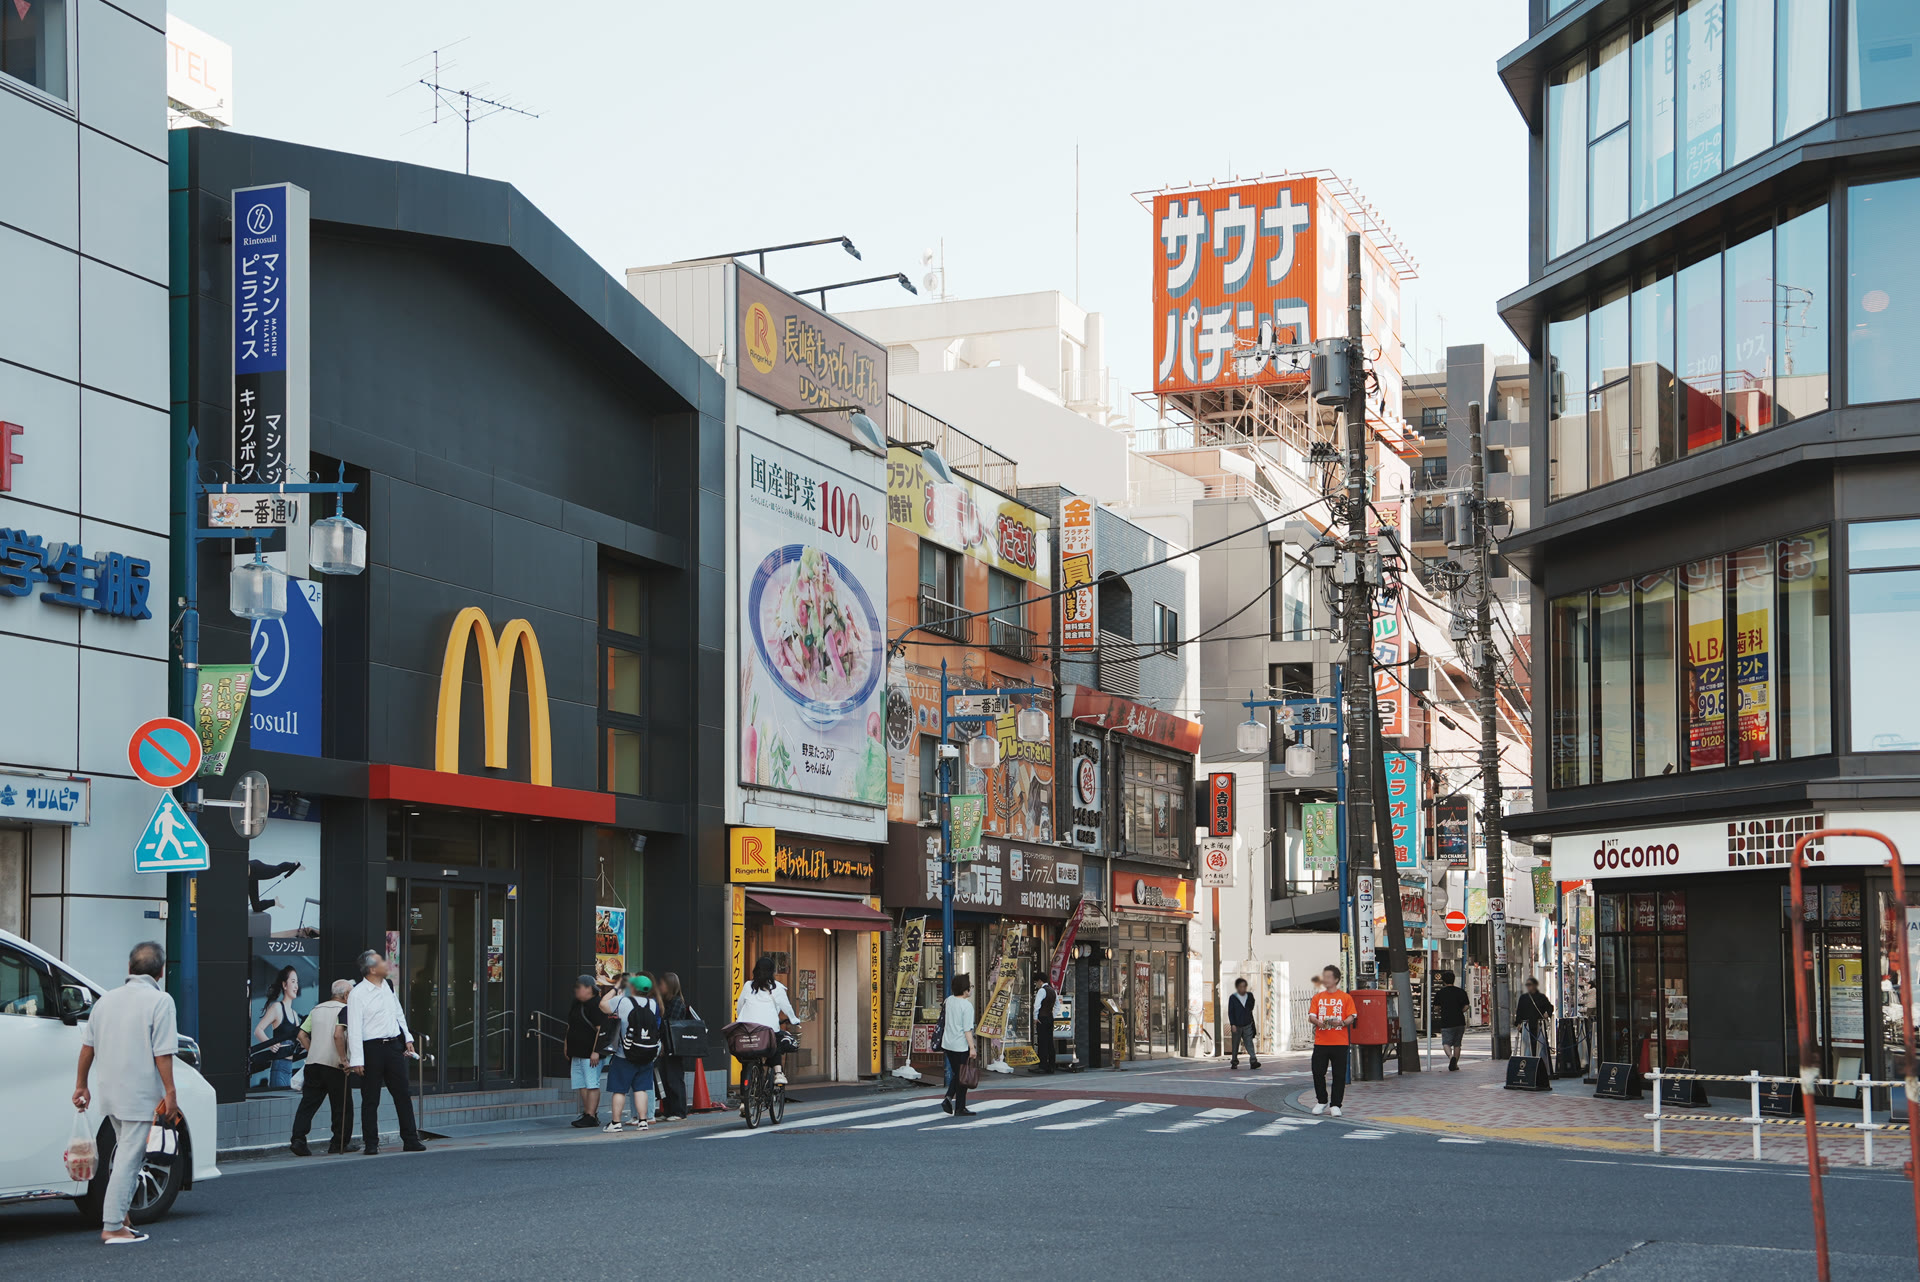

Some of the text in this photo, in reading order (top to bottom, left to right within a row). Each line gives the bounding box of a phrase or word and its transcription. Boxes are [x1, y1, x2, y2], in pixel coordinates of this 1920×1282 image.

[243, 235, 277, 246] Rintosull
[1161, 189, 1309, 292] サウナ
[262, 253, 279, 316] マシン
[242, 254, 259, 360] ピラティス
[1159, 306, 1310, 383] パチンコ
[783, 315, 882, 408] 長崎ちゃんぽん
[800, 375, 851, 424] リンガーハ
[240, 499, 298, 524] 一番通り
[751, 454, 879, 551] 国産野菜 100%
[889, 495, 912, 523] 時計
[1064, 500, 1091, 527] 金
[1370, 508, 1399, 528] 麻
[0, 528, 152, 619] 学生服
[308, 585, 321, 603] 2F
[1063, 555, 1092, 620] 買います
[1078, 589, 1087, 617] なんでも
[1065, 622, 1091, 630] 無料査定
[909, 679, 940, 703] ROLE
[973, 698, 1009, 714] 一番通り
[1294, 706, 1329, 722] 一番通り
[802, 743, 834, 761] 野菜たっぷり
[26, 787, 79, 811] オリムピア
[1390, 758, 1408, 862] カラオケ館
[1594, 840, 1680, 870] docomo
[1607, 838, 1619, 846] NTT
[735, 867, 756, 875] Ringer
[775, 846, 874, 879] 崎ちゃんぽん リンガーハット
[1024, 859, 1054, 884] キノクラム
[1029, 891, 1070, 911] 0120-211-415
[267, 942, 304, 953] マシンジム
[872, 942, 880, 1060] お持ち帰りできます
